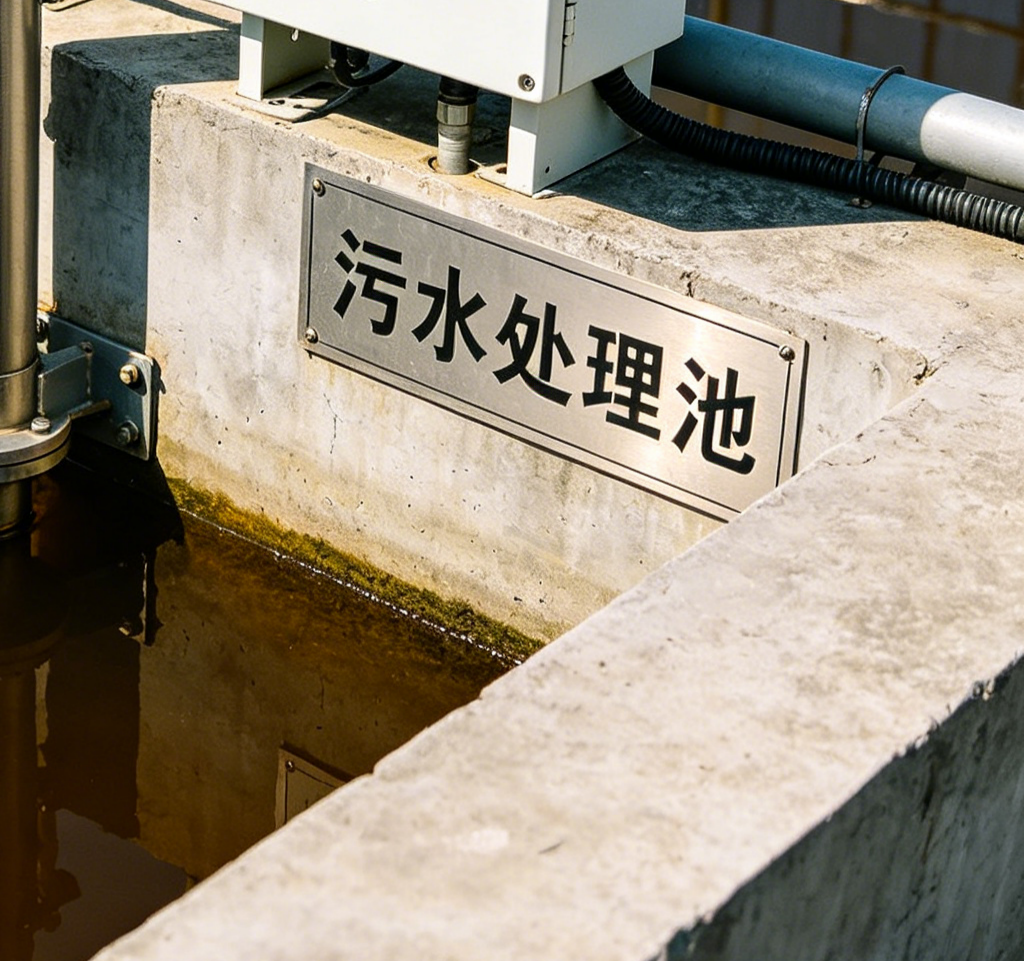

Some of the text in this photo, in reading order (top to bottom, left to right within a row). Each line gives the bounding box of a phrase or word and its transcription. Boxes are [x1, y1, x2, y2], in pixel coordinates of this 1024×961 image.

[332, 228, 756, 475] 污水处理池
